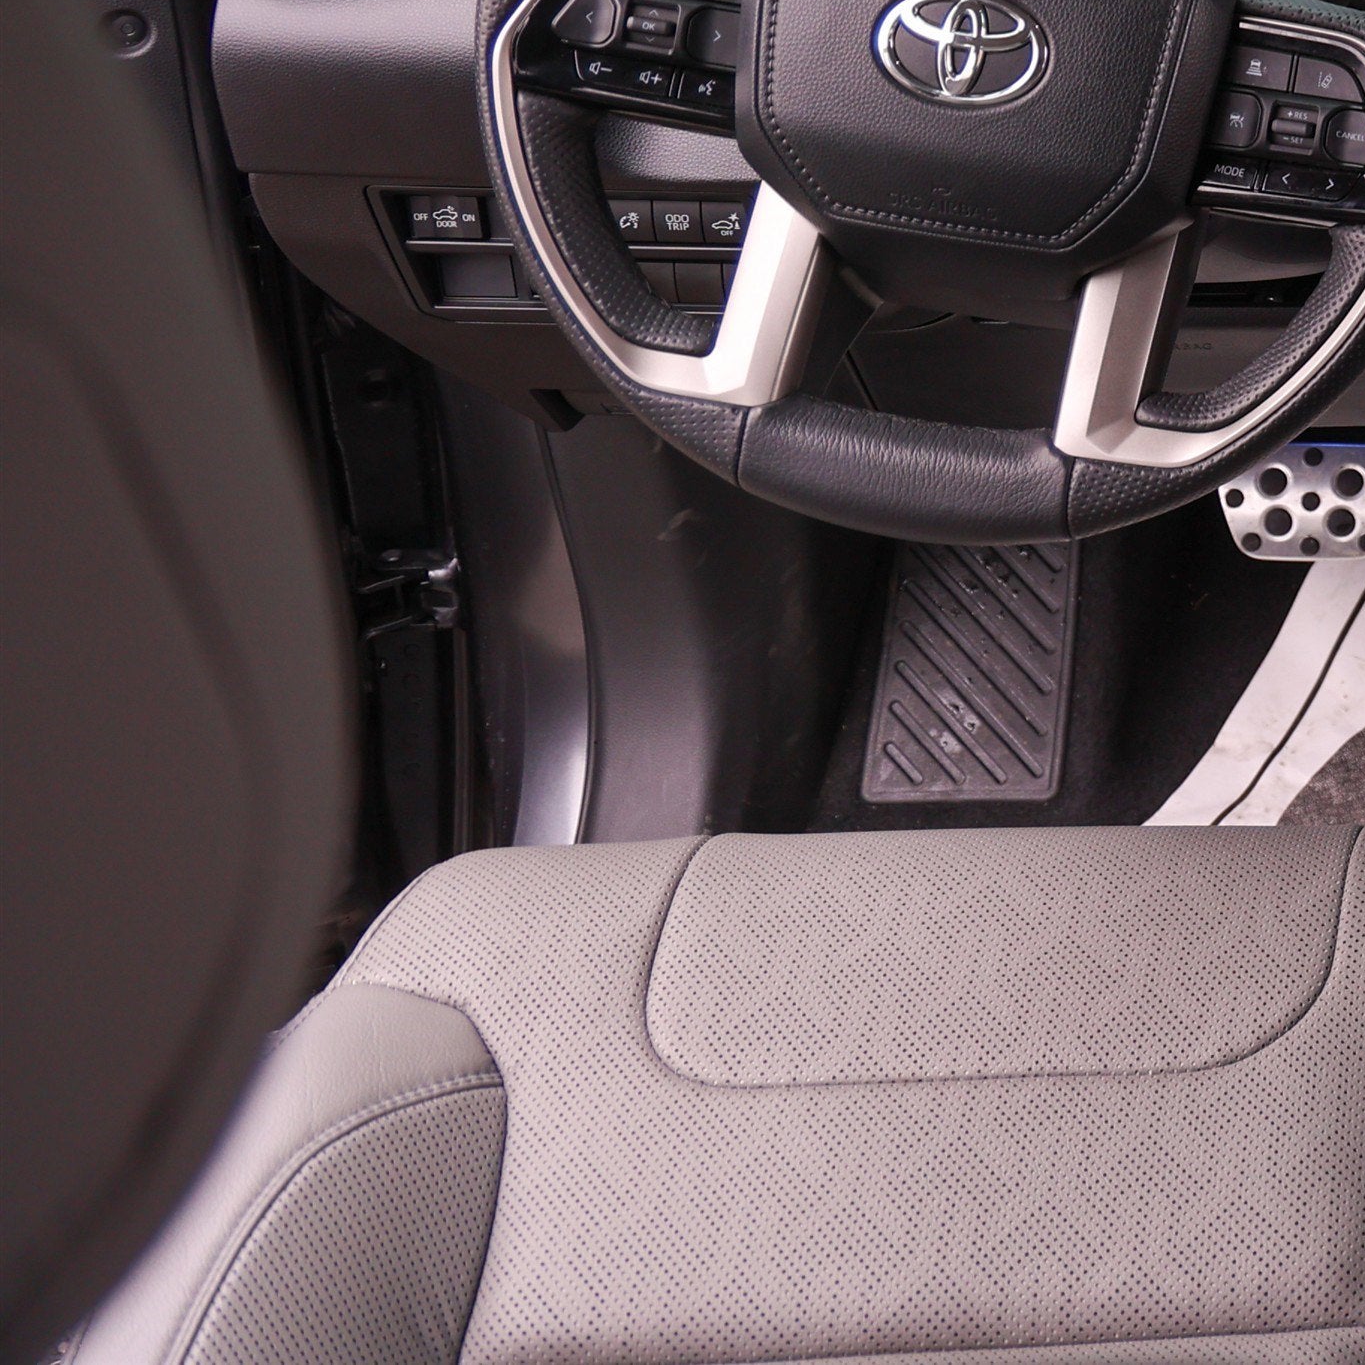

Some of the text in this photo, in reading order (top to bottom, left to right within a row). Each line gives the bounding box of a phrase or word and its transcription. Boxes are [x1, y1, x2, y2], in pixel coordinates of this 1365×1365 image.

[641, 21, 656, 31] OK
[1335, 130, 1365, 142] CANCEL
[1214, 163, 1246, 178] MODE
[413, 212, 429, 221] OFF
[462, 213, 476, 222] ON
[665, 214, 690, 223] ODO
[436, 220, 458, 228] DOOR
[666, 222, 690, 231] TRIP
